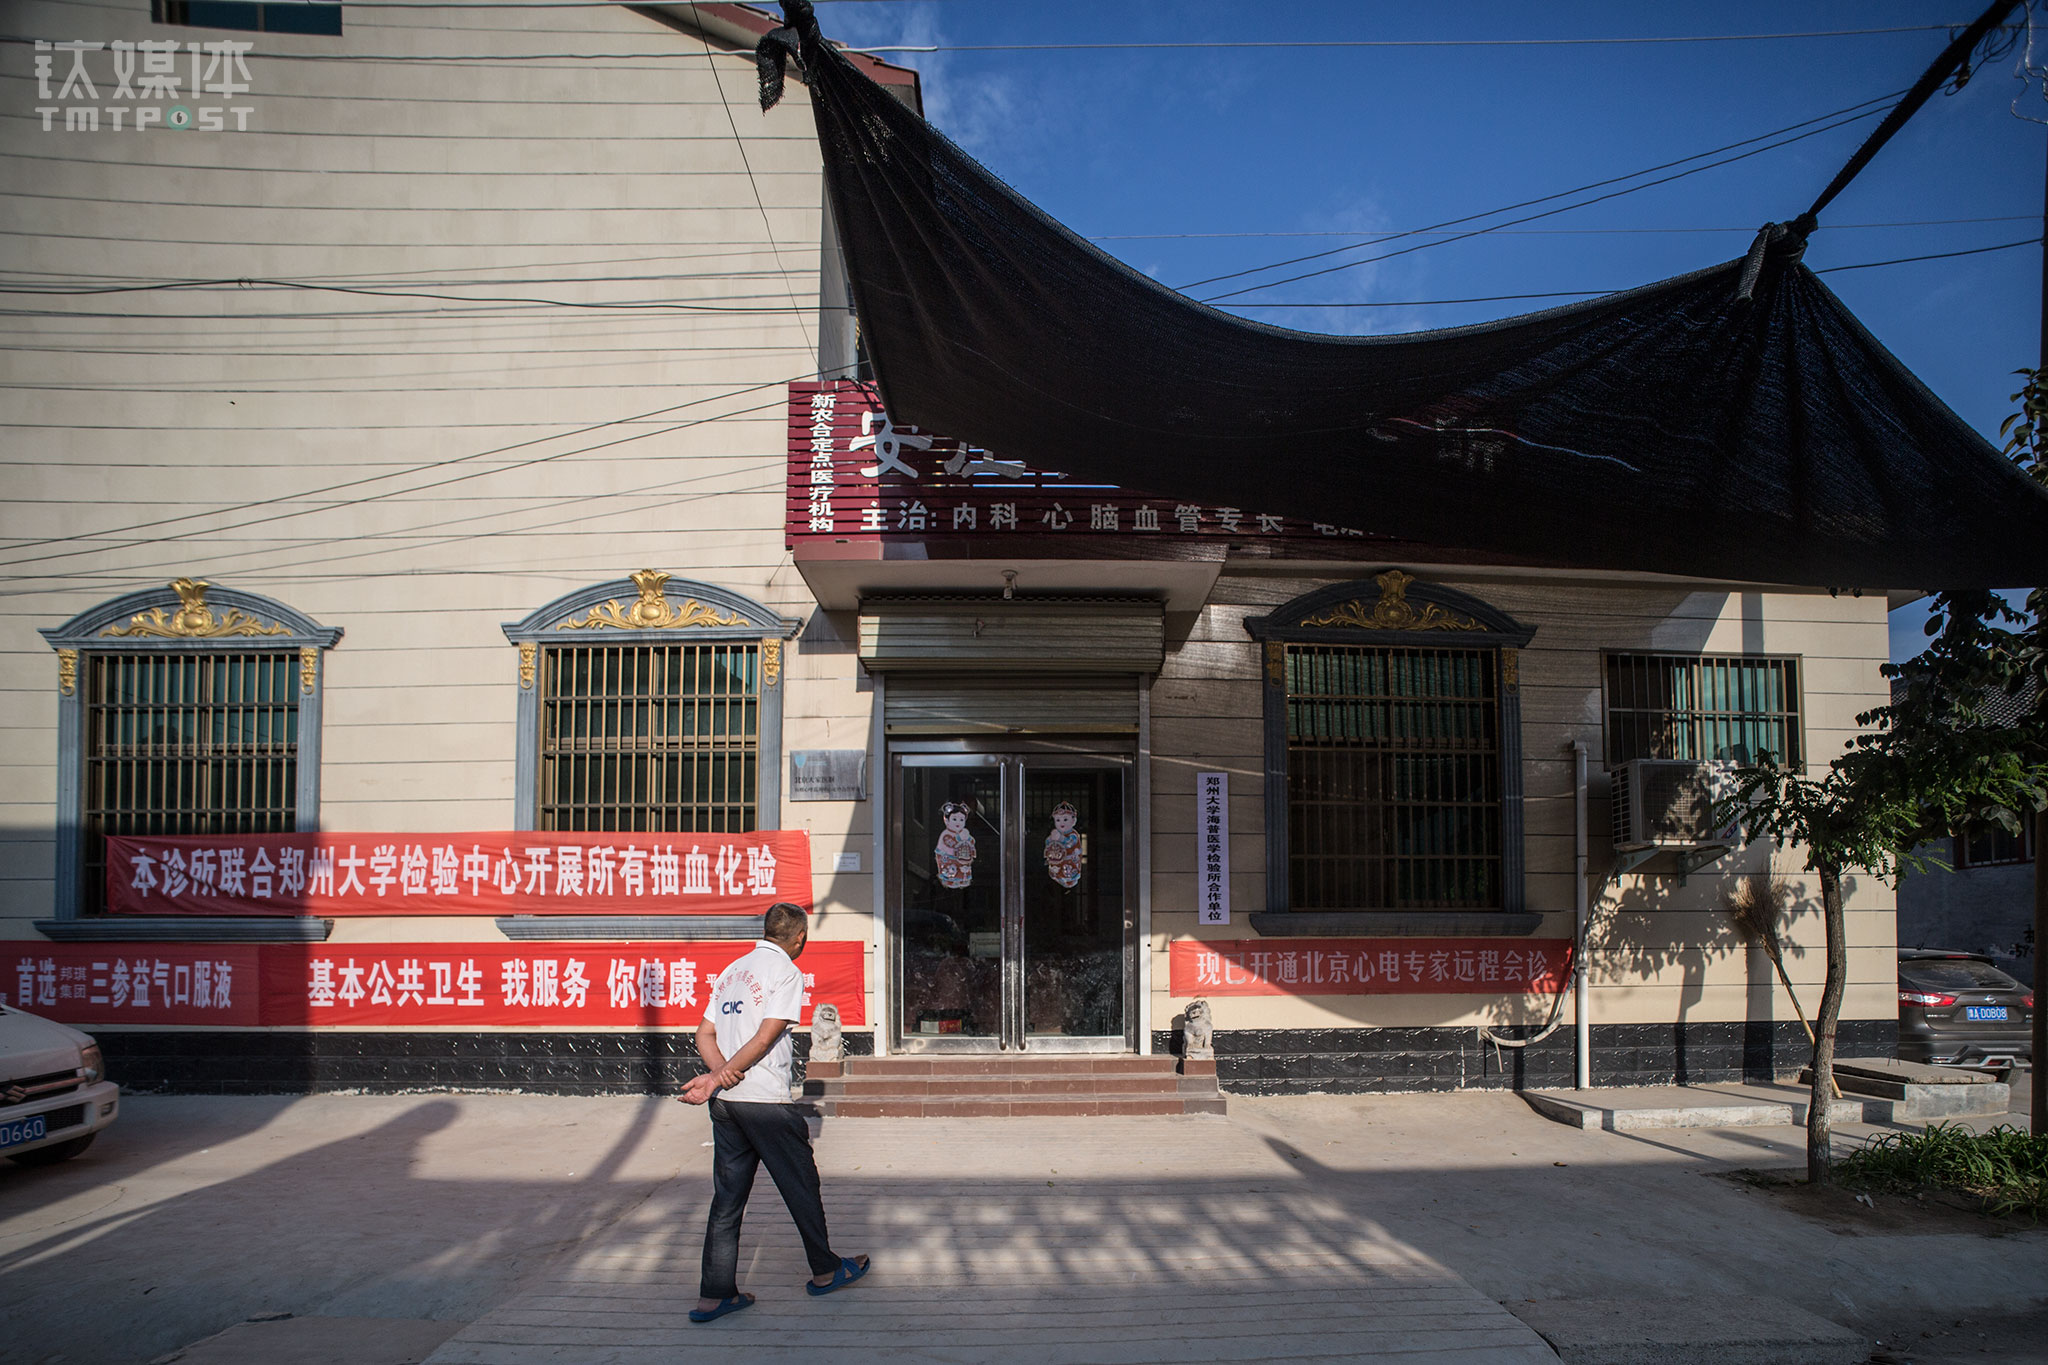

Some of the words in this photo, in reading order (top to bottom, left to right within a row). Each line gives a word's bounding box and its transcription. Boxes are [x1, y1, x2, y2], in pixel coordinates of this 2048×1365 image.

[808, 394, 836, 532] 新农合定点医疗机构
[131, 844, 777, 898] 本诊所联合郑州大学检验中心开展所有抽血化验
[1206, 777, 1222, 921] 郑州大学海普医学检验所合作单位
[16, 957, 56, 1007] 首选
[90, 957, 232, 1009] 三参益气口服液
[308, 957, 485, 1008] 基本公共卫生
[501, 957, 591, 1008] 我服务
[606, 957, 697, 1009] 你健康
[1197, 950, 1548, 986] 现已开通北京心电专家远程会诊
